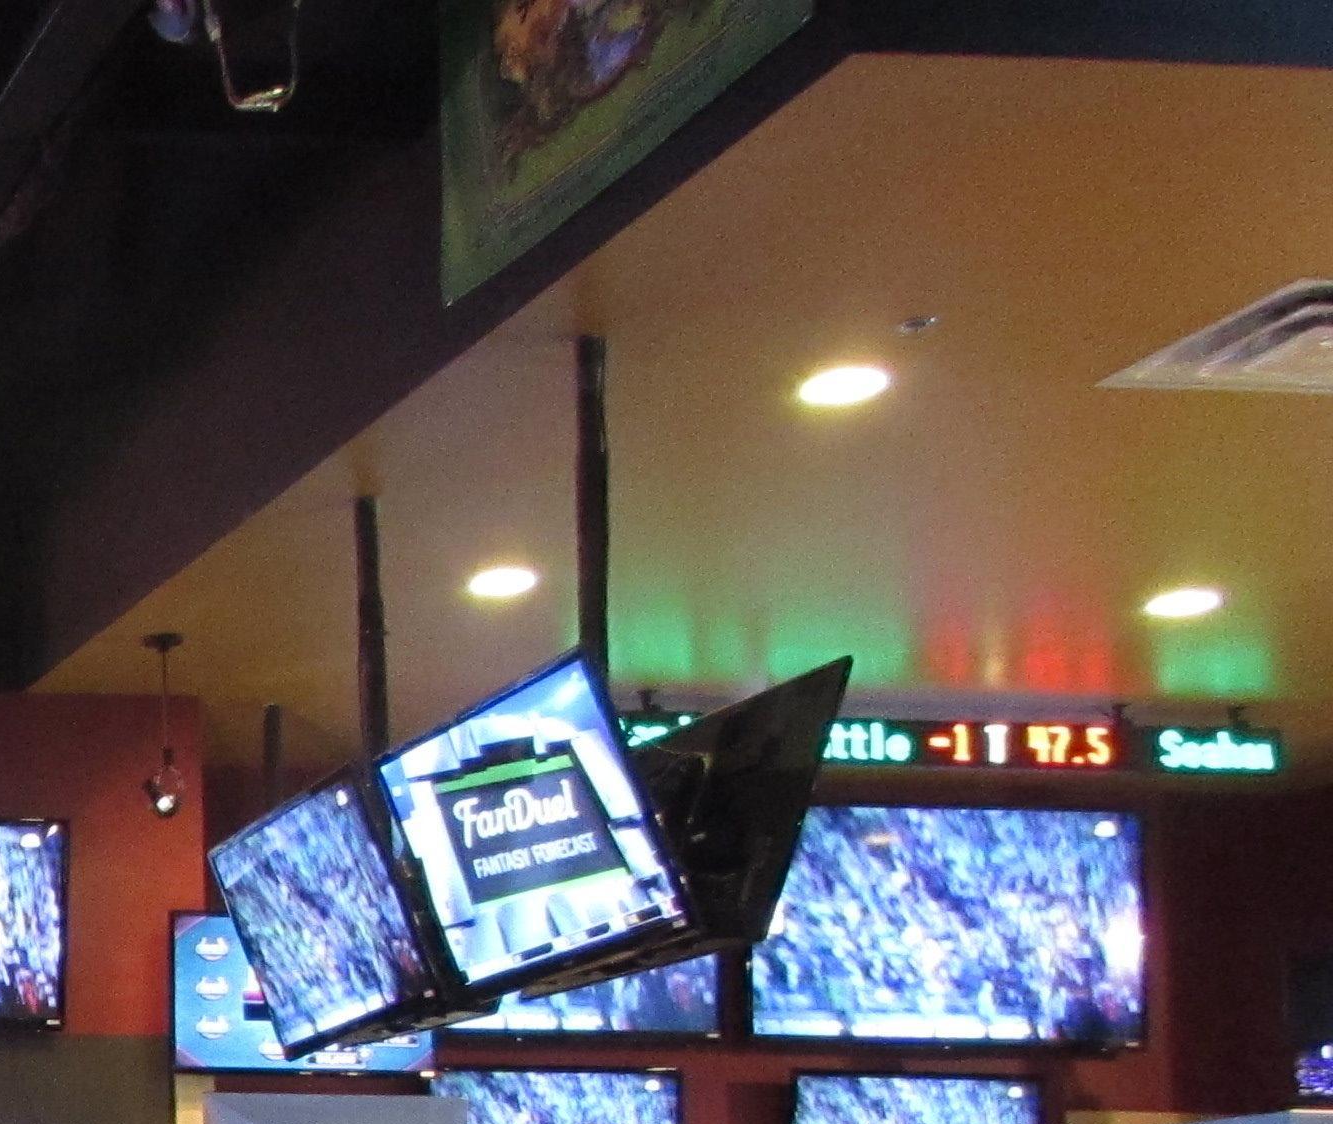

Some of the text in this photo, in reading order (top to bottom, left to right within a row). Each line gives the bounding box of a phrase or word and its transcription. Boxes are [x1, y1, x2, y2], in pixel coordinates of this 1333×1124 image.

[929, 723, 971, 762] -1
[453, 779, 579, 848] FanDuel
[473, 832, 599, 879] FANTASY FORECAST
